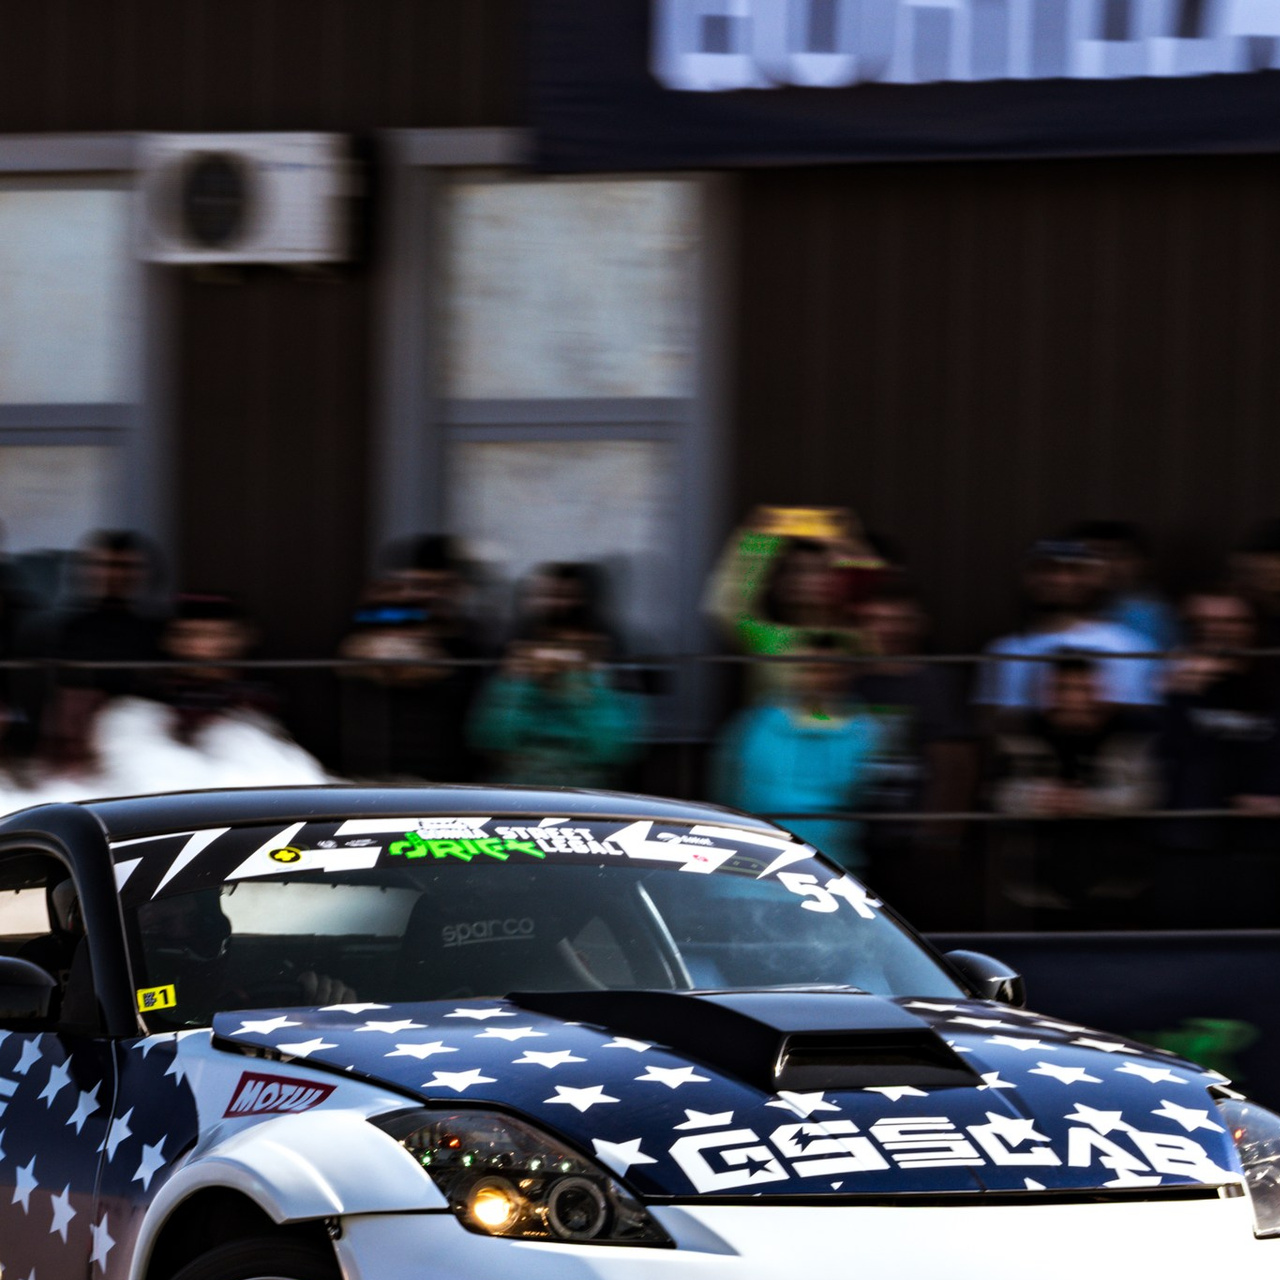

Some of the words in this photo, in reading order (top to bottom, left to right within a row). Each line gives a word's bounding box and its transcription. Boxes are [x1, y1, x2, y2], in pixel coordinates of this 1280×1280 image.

[494, 826, 595, 841] STREET
[536, 838, 625, 856] LEGAL
[441, 917, 535, 947] sparco
[229, 1079, 325, 1112] MOTUL
